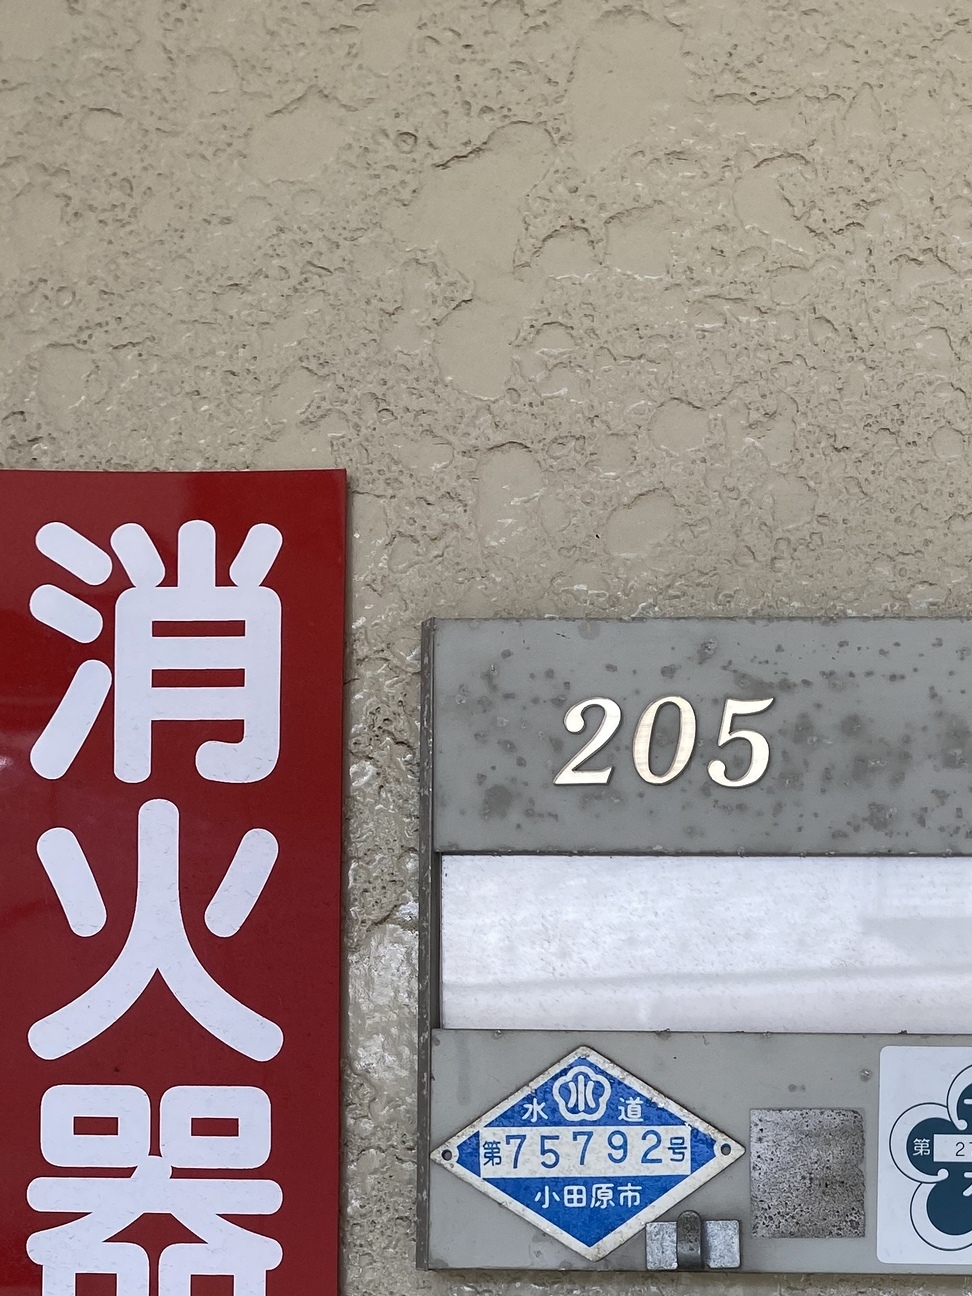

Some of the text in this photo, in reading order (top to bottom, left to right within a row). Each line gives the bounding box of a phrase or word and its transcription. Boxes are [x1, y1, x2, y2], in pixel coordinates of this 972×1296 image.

[553, 694, 775, 789] 205
[482, 1129, 688, 1169] 第75792号
[534, 1182, 643, 1209] 小田原市
